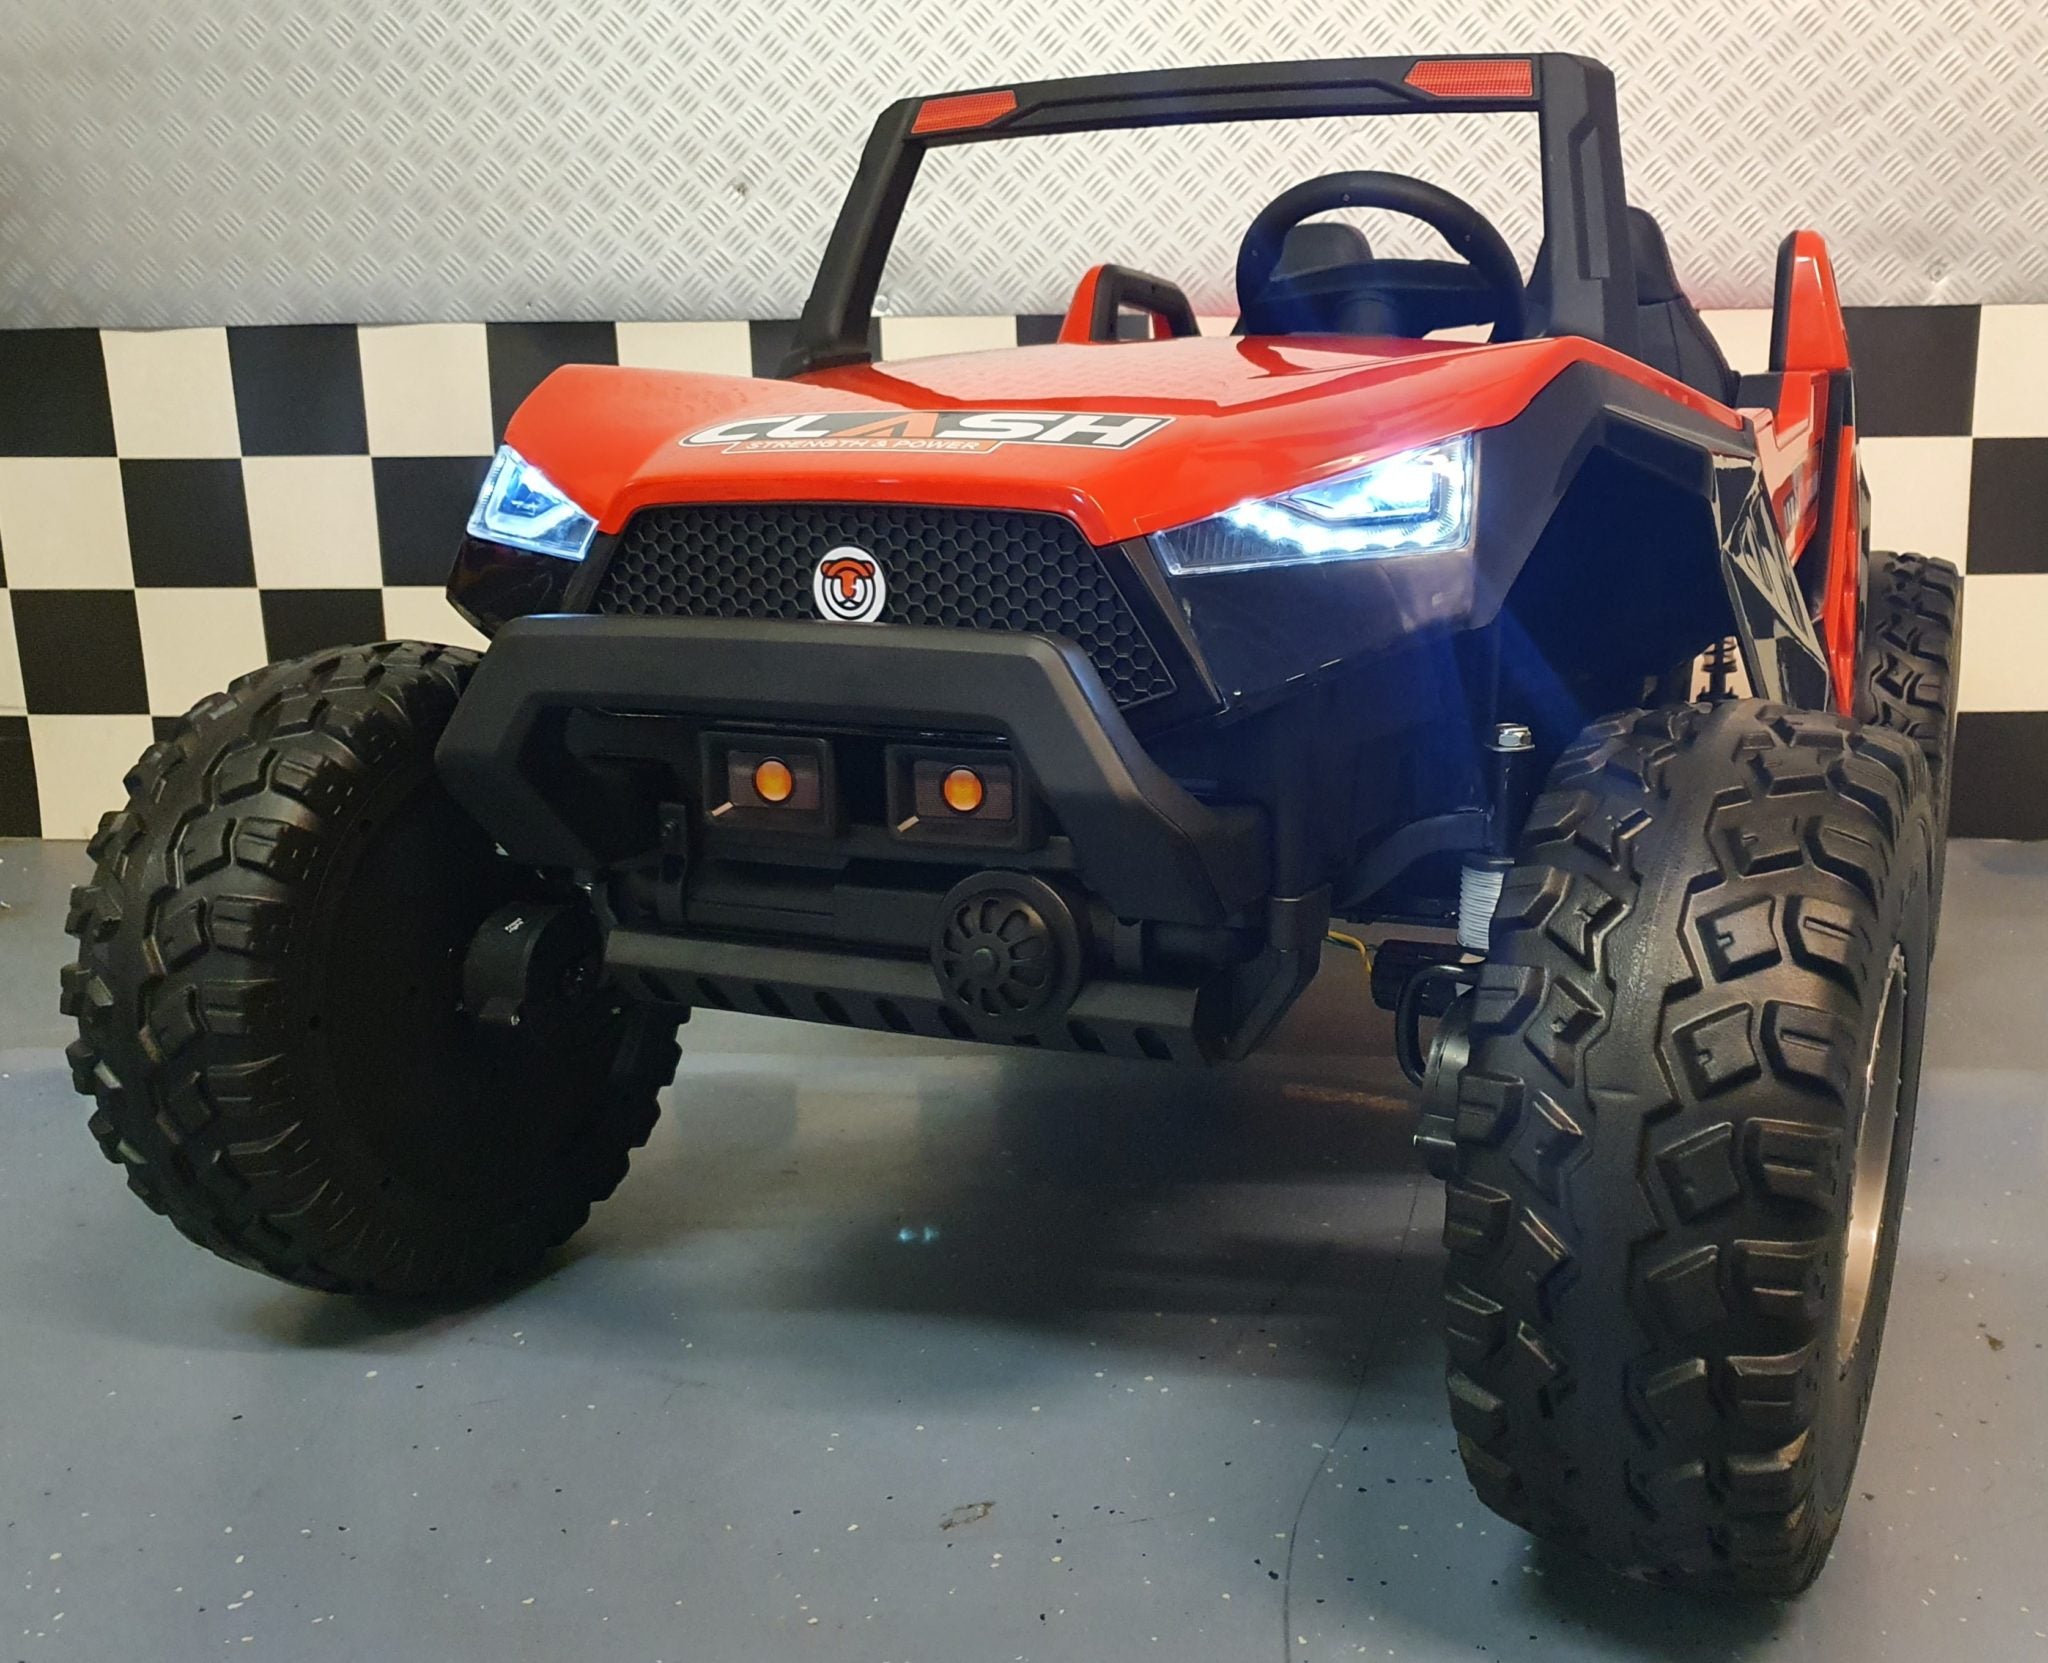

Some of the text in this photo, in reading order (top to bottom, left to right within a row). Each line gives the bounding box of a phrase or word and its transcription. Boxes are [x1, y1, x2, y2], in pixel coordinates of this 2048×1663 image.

[689, 412, 1162, 446] CLASH
[745, 439, 980, 450] STRENGTH & POWER
